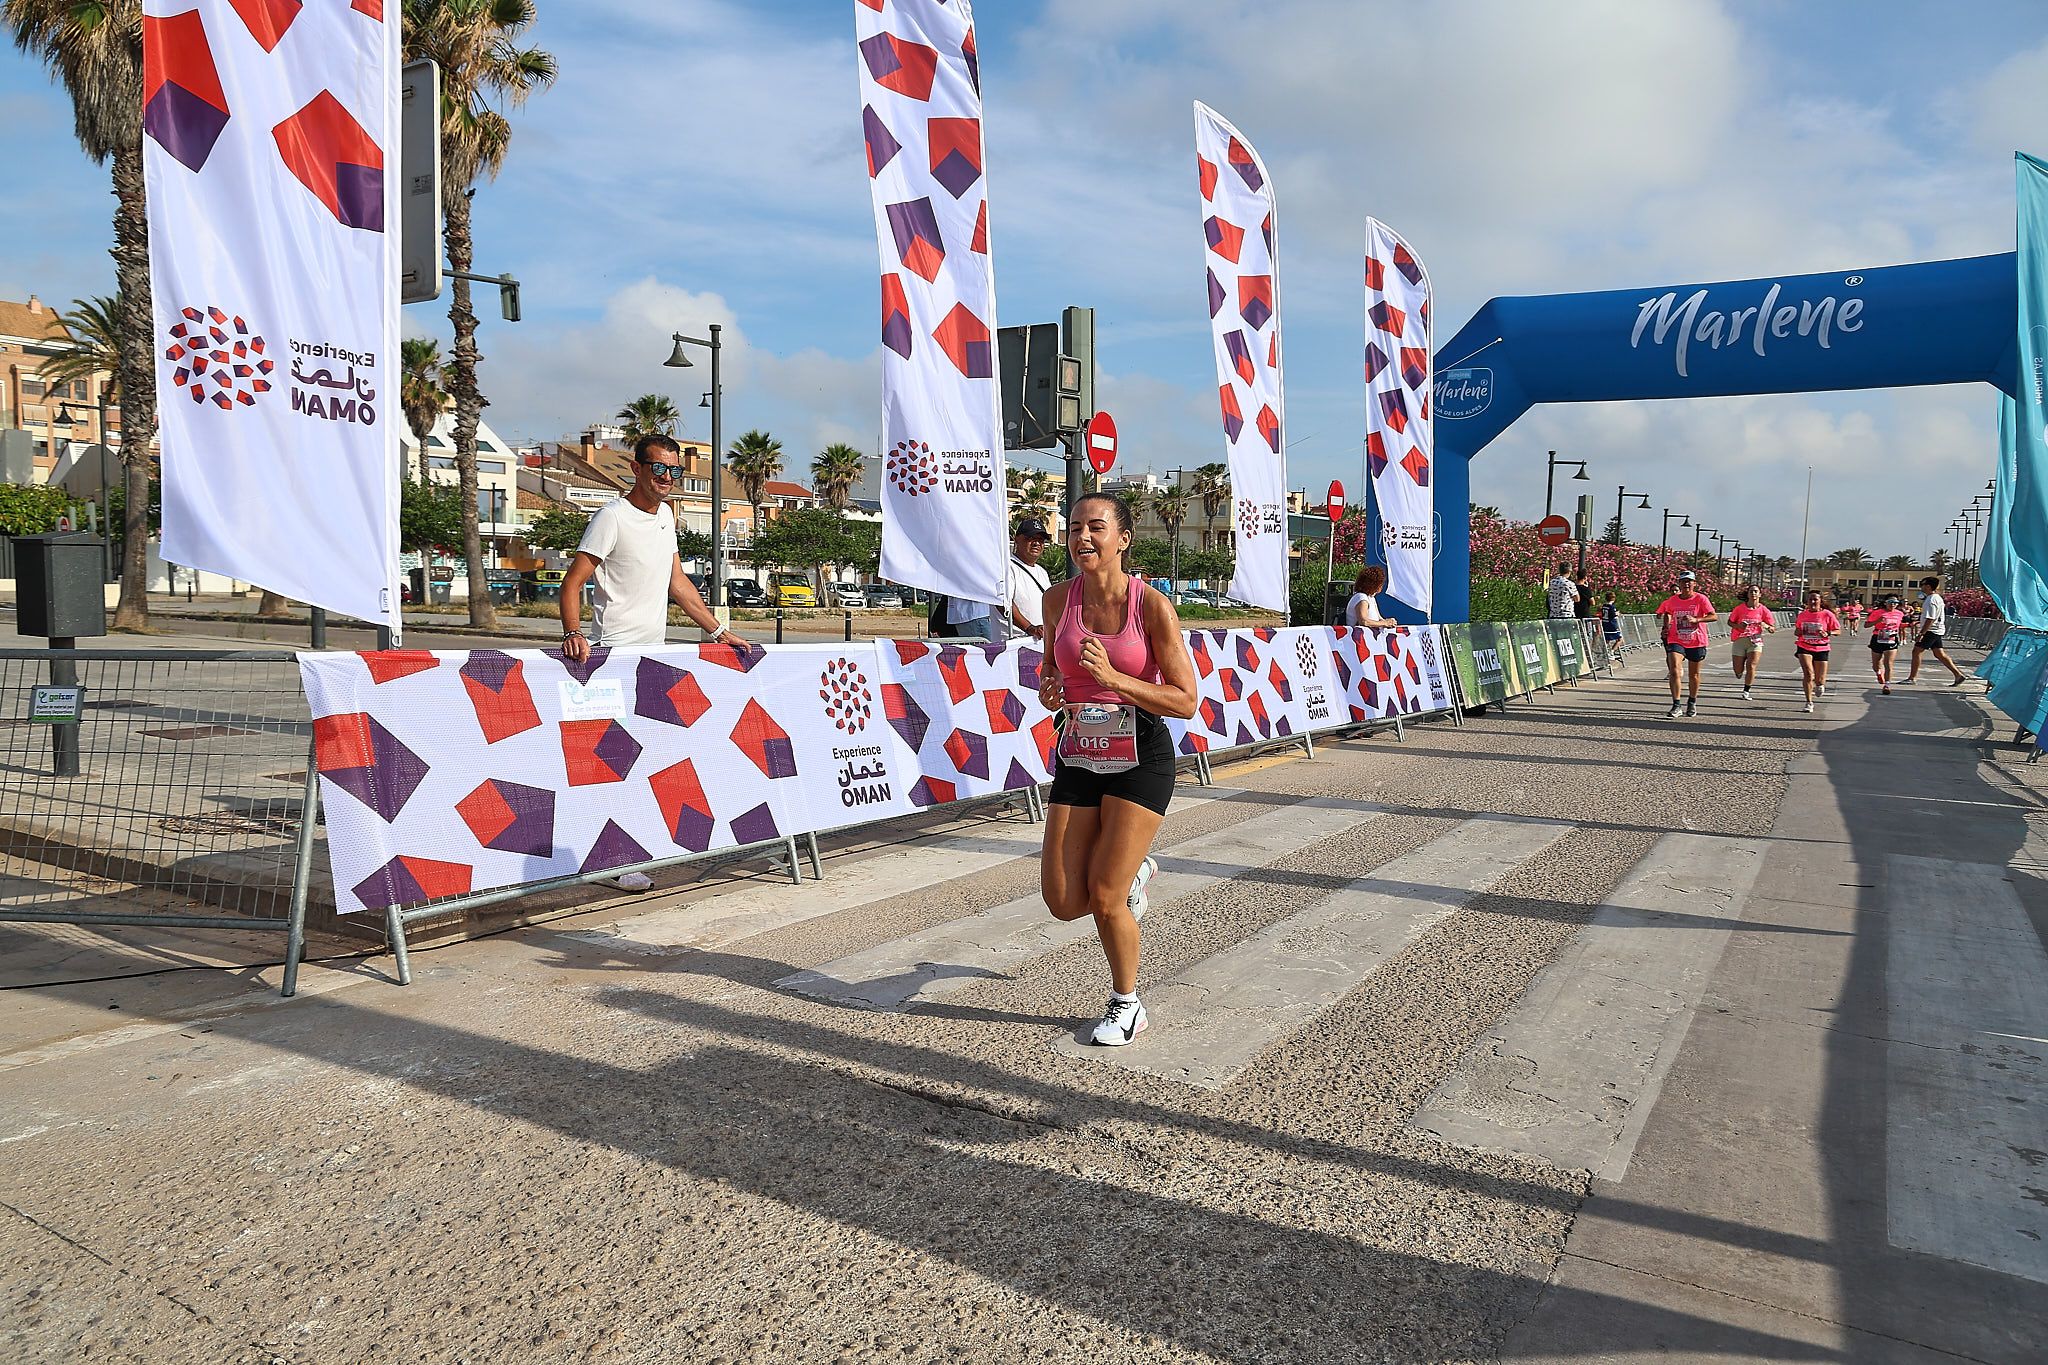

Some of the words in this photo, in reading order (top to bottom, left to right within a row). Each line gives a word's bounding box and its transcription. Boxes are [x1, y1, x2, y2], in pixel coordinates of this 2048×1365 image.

[1631, 283, 1864, 377] Marlene
[1309, 707, 1329, 720] OMAN
[1080, 736, 1110, 750] 016
[832, 745, 882, 761] Experience
[841, 783, 892, 807] OMAN
